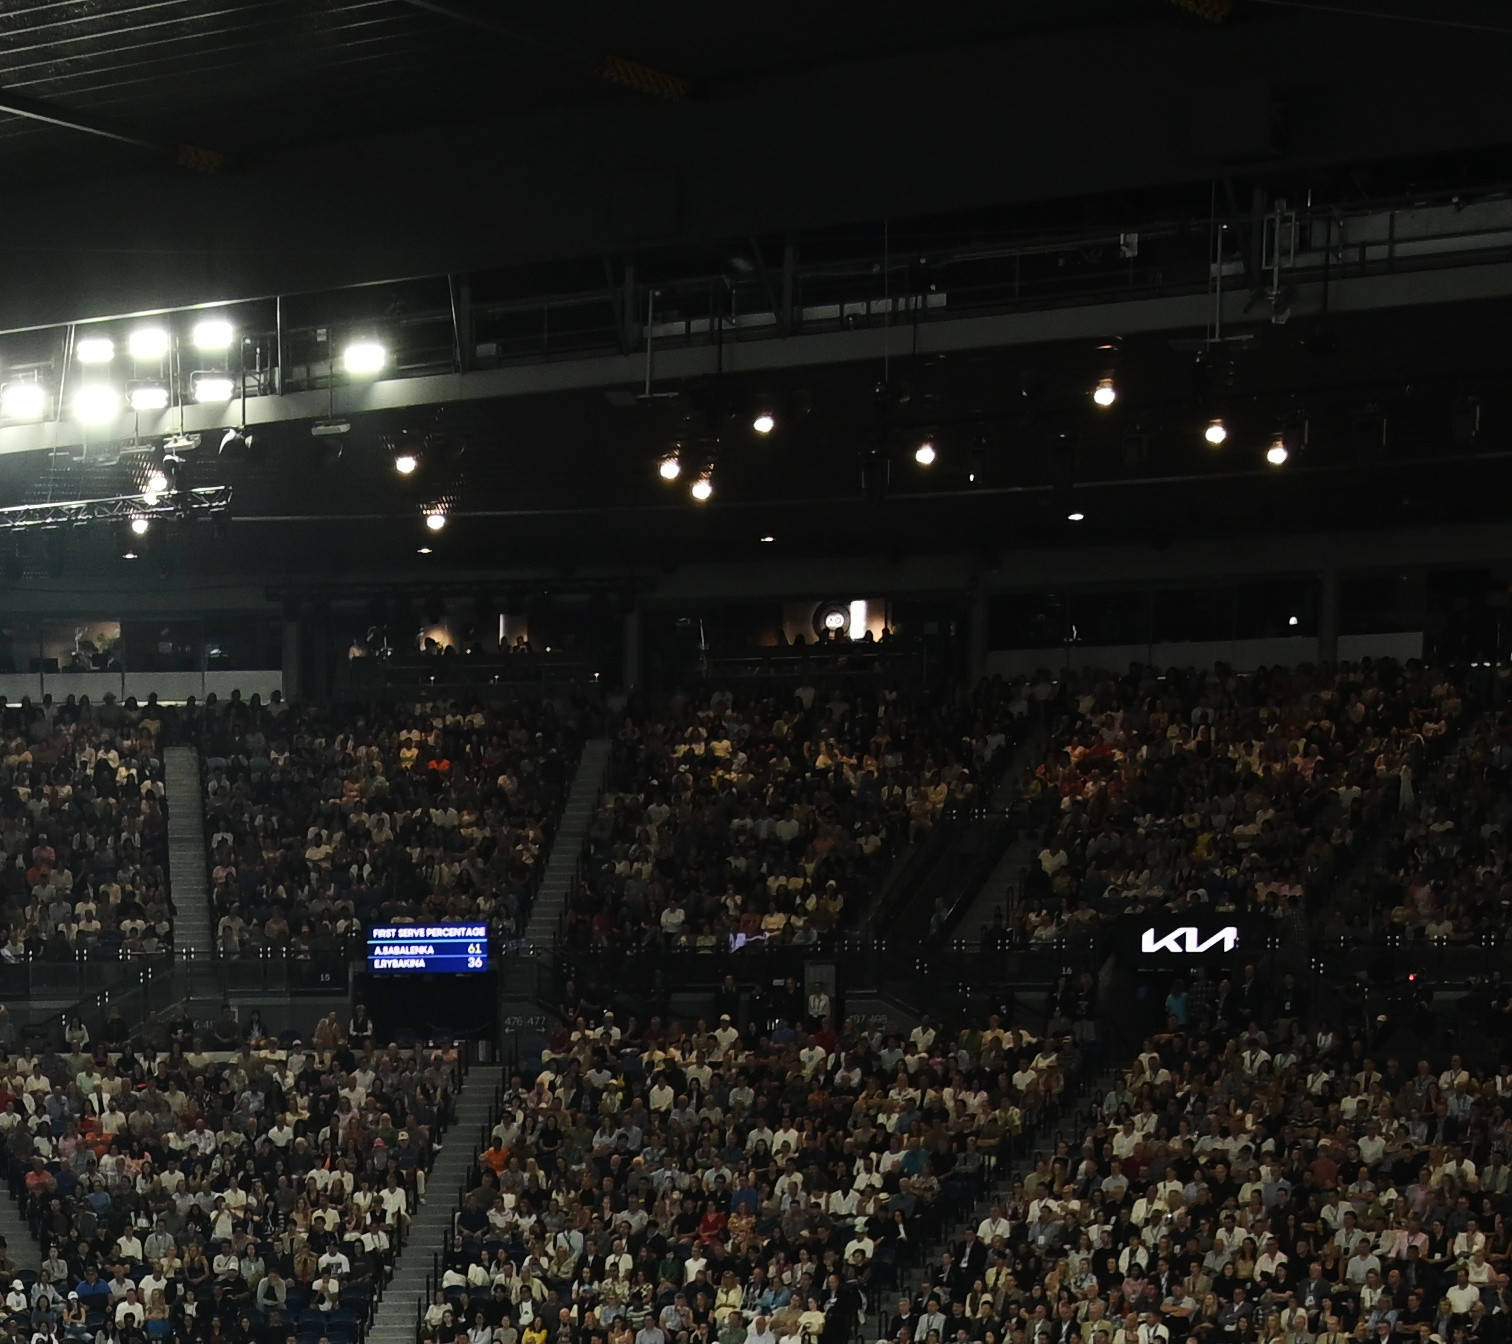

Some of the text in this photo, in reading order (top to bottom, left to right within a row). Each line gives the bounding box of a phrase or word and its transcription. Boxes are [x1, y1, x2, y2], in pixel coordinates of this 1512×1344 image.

[373, 926, 486, 938] FIRST SERVE PERCENTAGE
[1142, 927, 1238, 953] KIA
[467, 943, 482, 954] 61
[467, 956, 483, 968] 36
